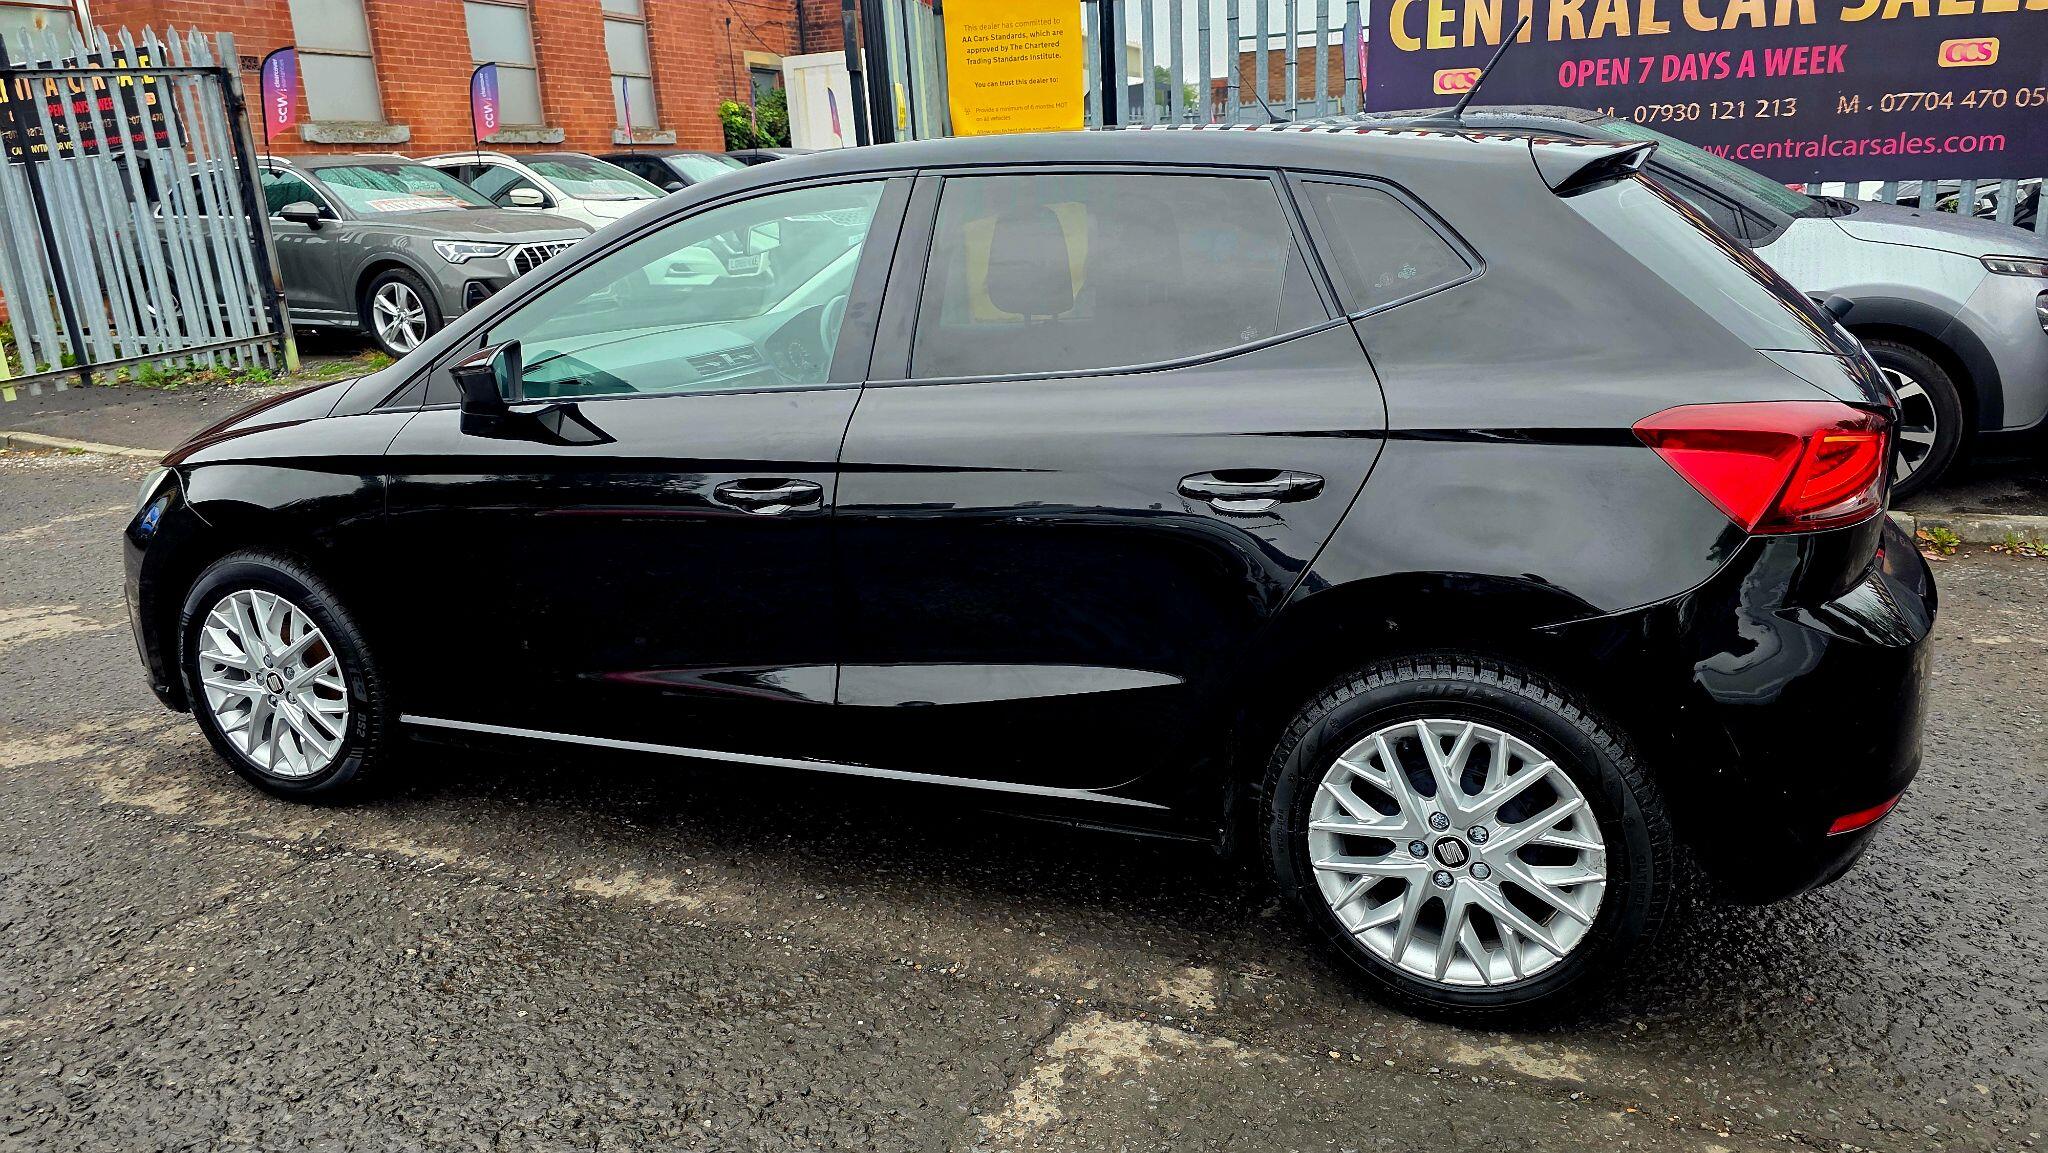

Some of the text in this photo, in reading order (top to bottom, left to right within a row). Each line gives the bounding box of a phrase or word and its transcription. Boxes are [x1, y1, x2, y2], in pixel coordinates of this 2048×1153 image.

[980, 23, 1000, 31] dealer
[1015, 18, 1052, 28] committed
[1389, 0, 1671, 51] CENTRAL
[991, 32, 1028, 41] Standards,
[1030, 30, 1051, 38] which
[967, 41, 1060, 55] approved by The Chartered
[1946, 41, 1993, 62] CCS
[966, 53, 1062, 66] Trading Standards Institute.
[1557, 44, 1848, 88] OPEN 7 DAYS A WEEK
[1029, 77, 1049, 85] dealer
[1633, 102, 1700, 123] 07930
[1710, 101, 1746, 120] 121
[1755, 98, 1797, 118] 213
[1837, 94, 1860, 114] M
[1880, 91, 1953, 113] 07704
[1961, 88, 2008, 109] 470
[2015, 87, 2048, 107] 05
[1702, 131, 2006, 160] w.centralcarsales.com
